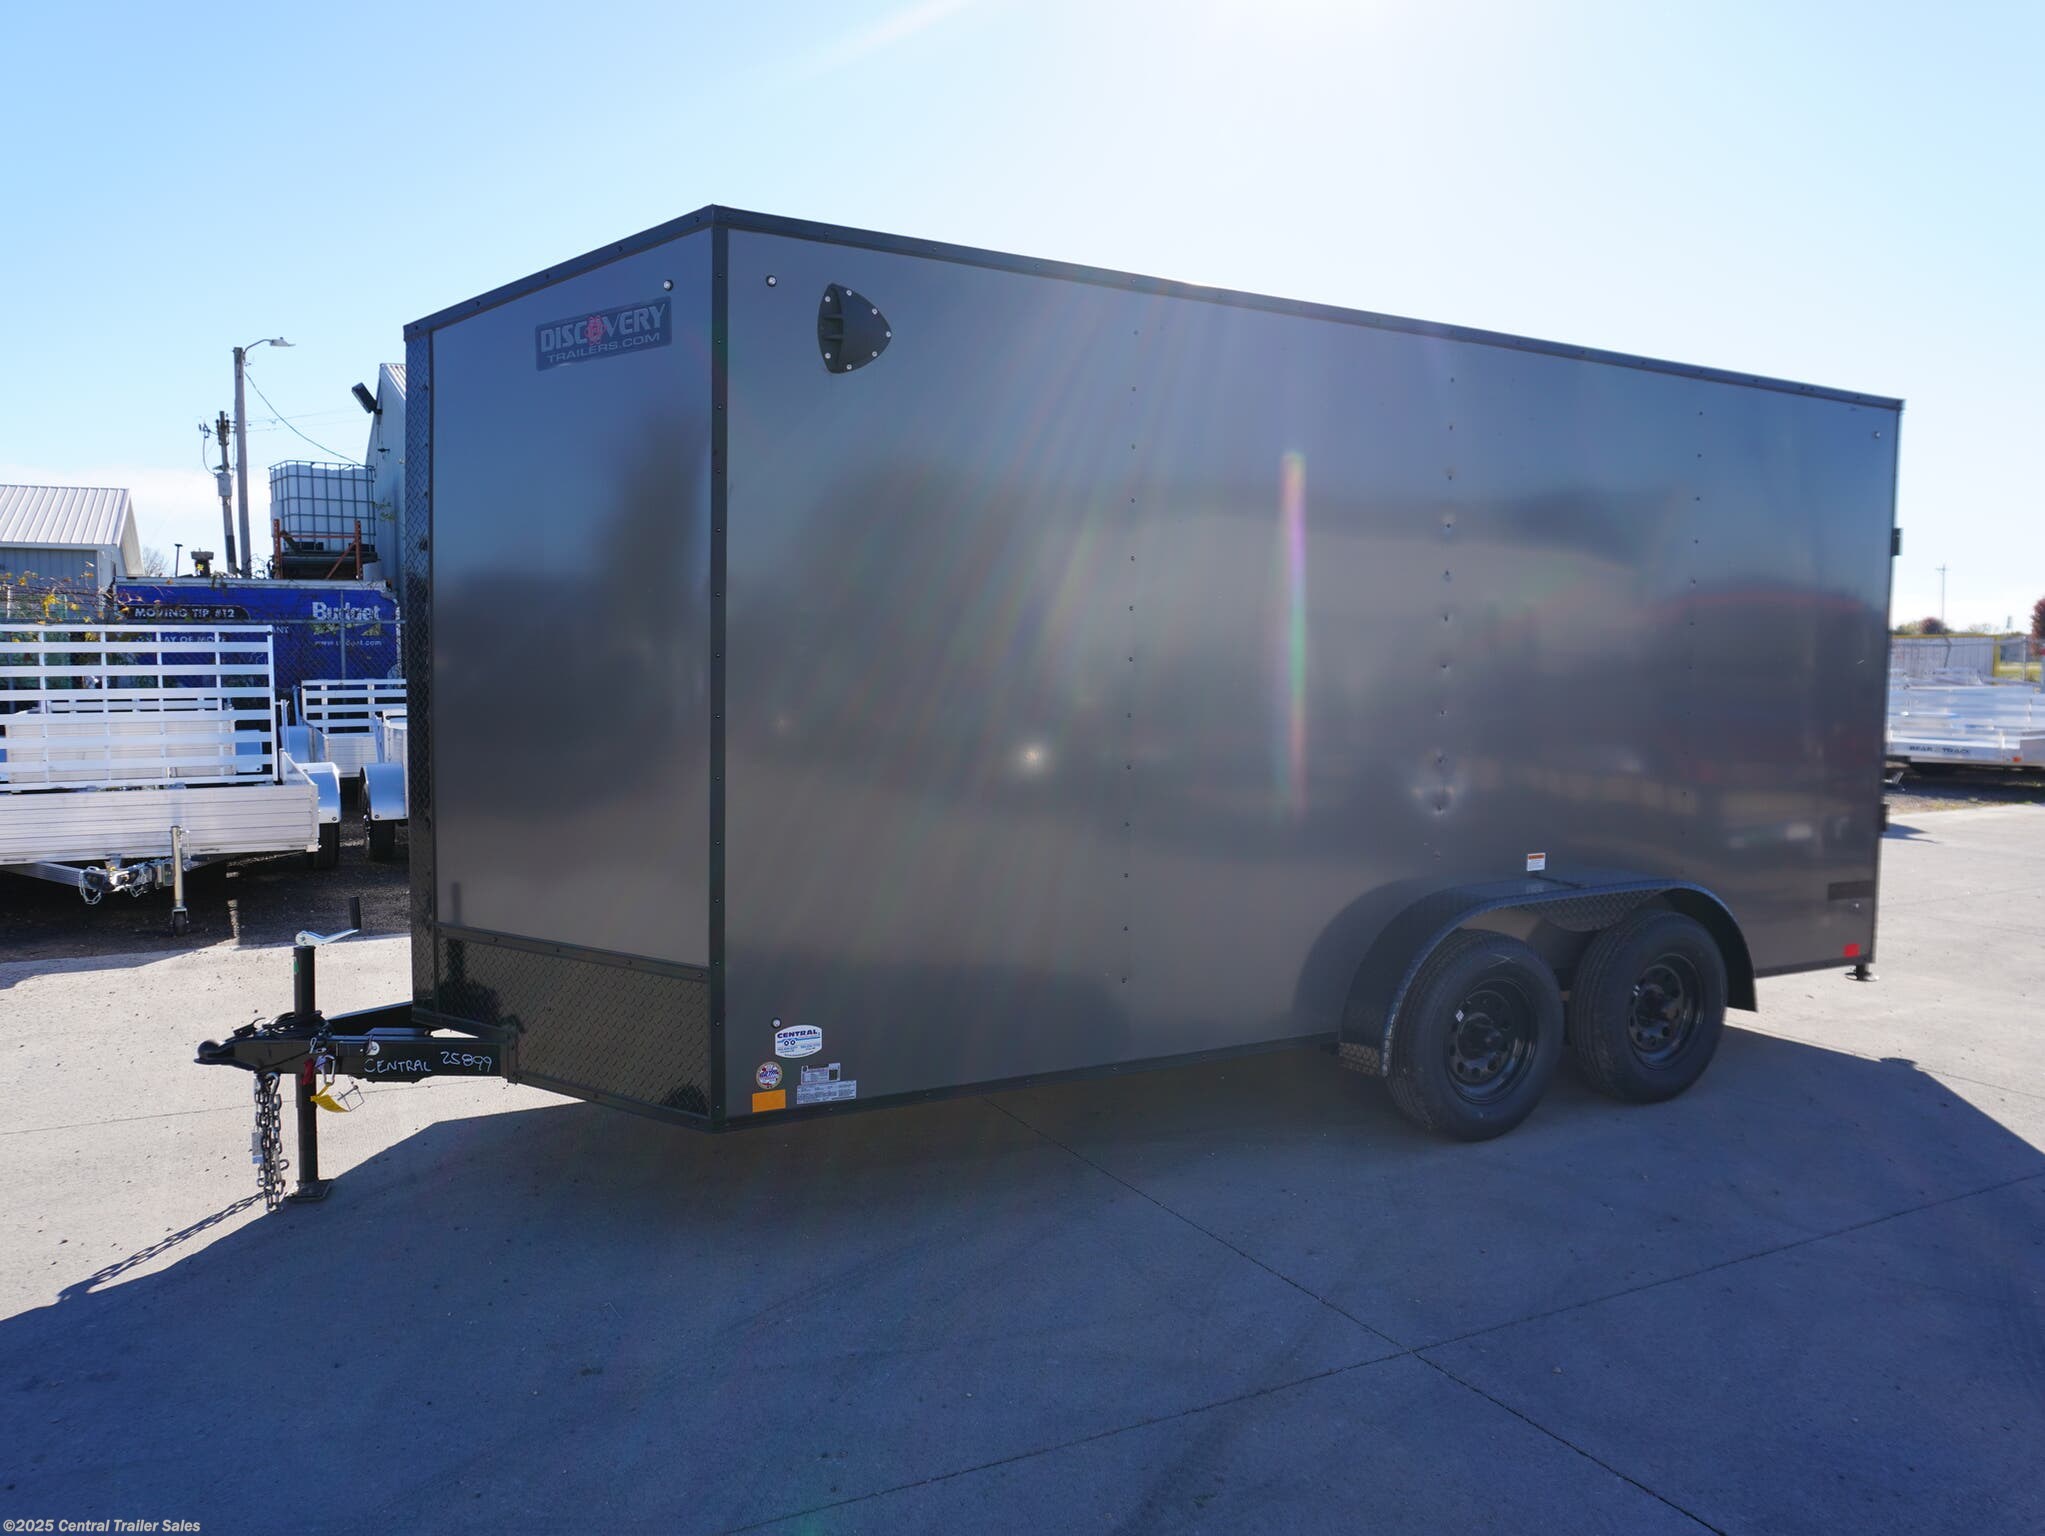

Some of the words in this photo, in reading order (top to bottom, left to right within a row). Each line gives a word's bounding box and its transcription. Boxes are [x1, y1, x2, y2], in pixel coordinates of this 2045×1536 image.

[540, 303, 666, 353] DISCOVERY
[547, 332, 660, 363] TRAILERS.COM
[134, 608, 188, 618] MOVING
[192, 608, 209, 618] TIP
[214, 608, 235, 618] #12
[312, 601, 381, 621] Budget
[777, 1030, 817, 1038] CENTRAL
[364, 1058, 432, 1073] CENTRAL
[440, 1051, 492, 1073] 25899
